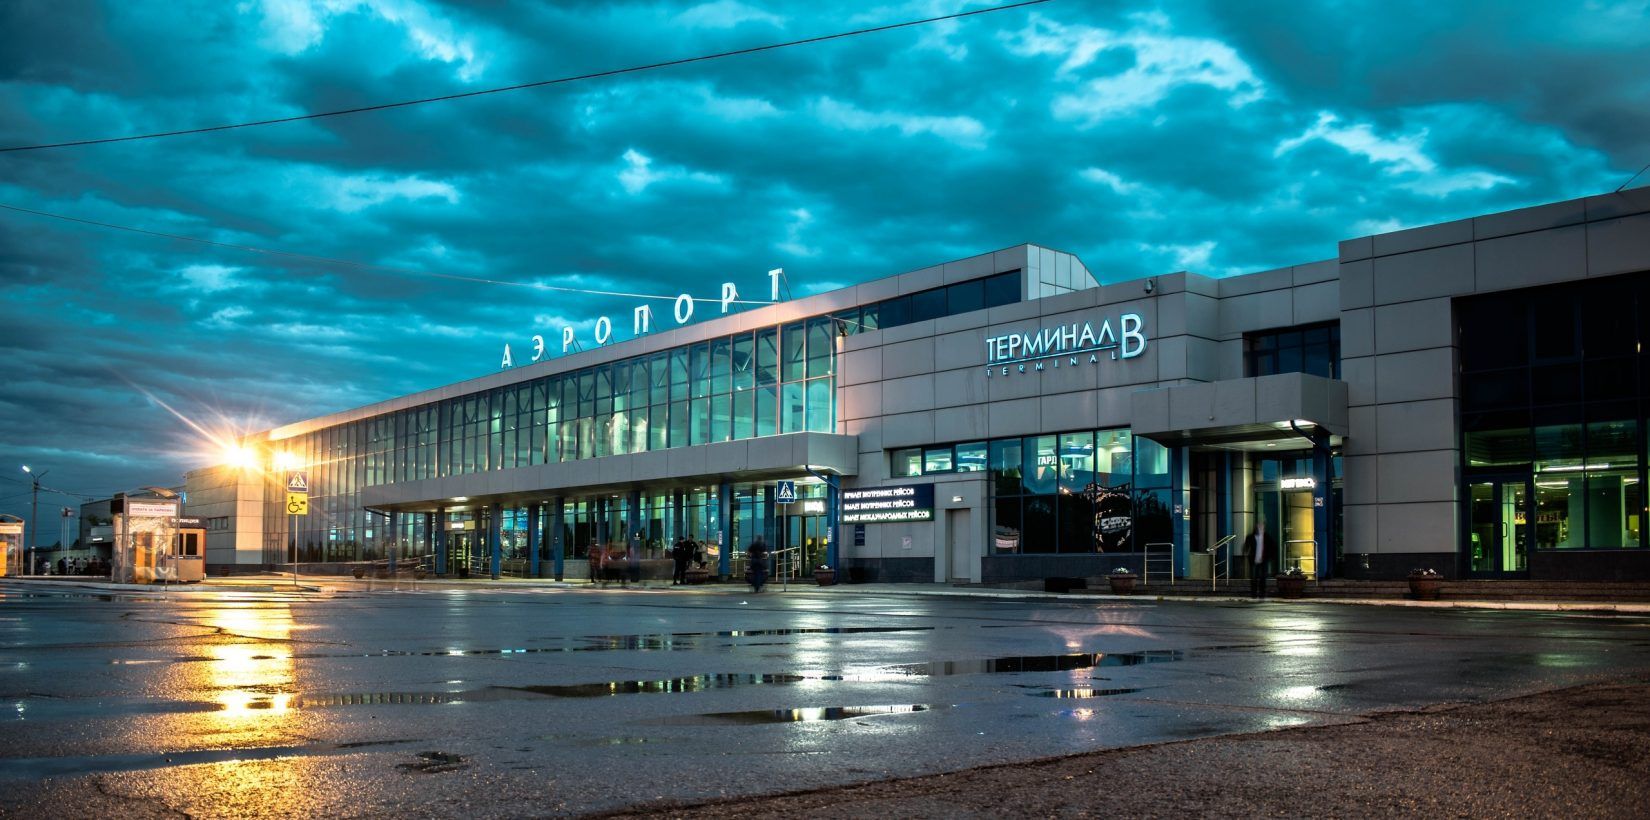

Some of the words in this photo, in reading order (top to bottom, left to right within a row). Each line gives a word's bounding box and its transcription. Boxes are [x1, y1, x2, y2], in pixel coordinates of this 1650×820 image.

[501, 268, 783, 368] АЭРОПОРТ
[986, 319, 1117, 361] ТЕРМИНАЛ
[986, 351, 1118, 377] TERMINAL
[893, 487, 914, 496] РЕЙСОВ
[893, 499, 914, 507] РЕЙСОВ
[908, 510, 930, 519] РЕЙСОВ
